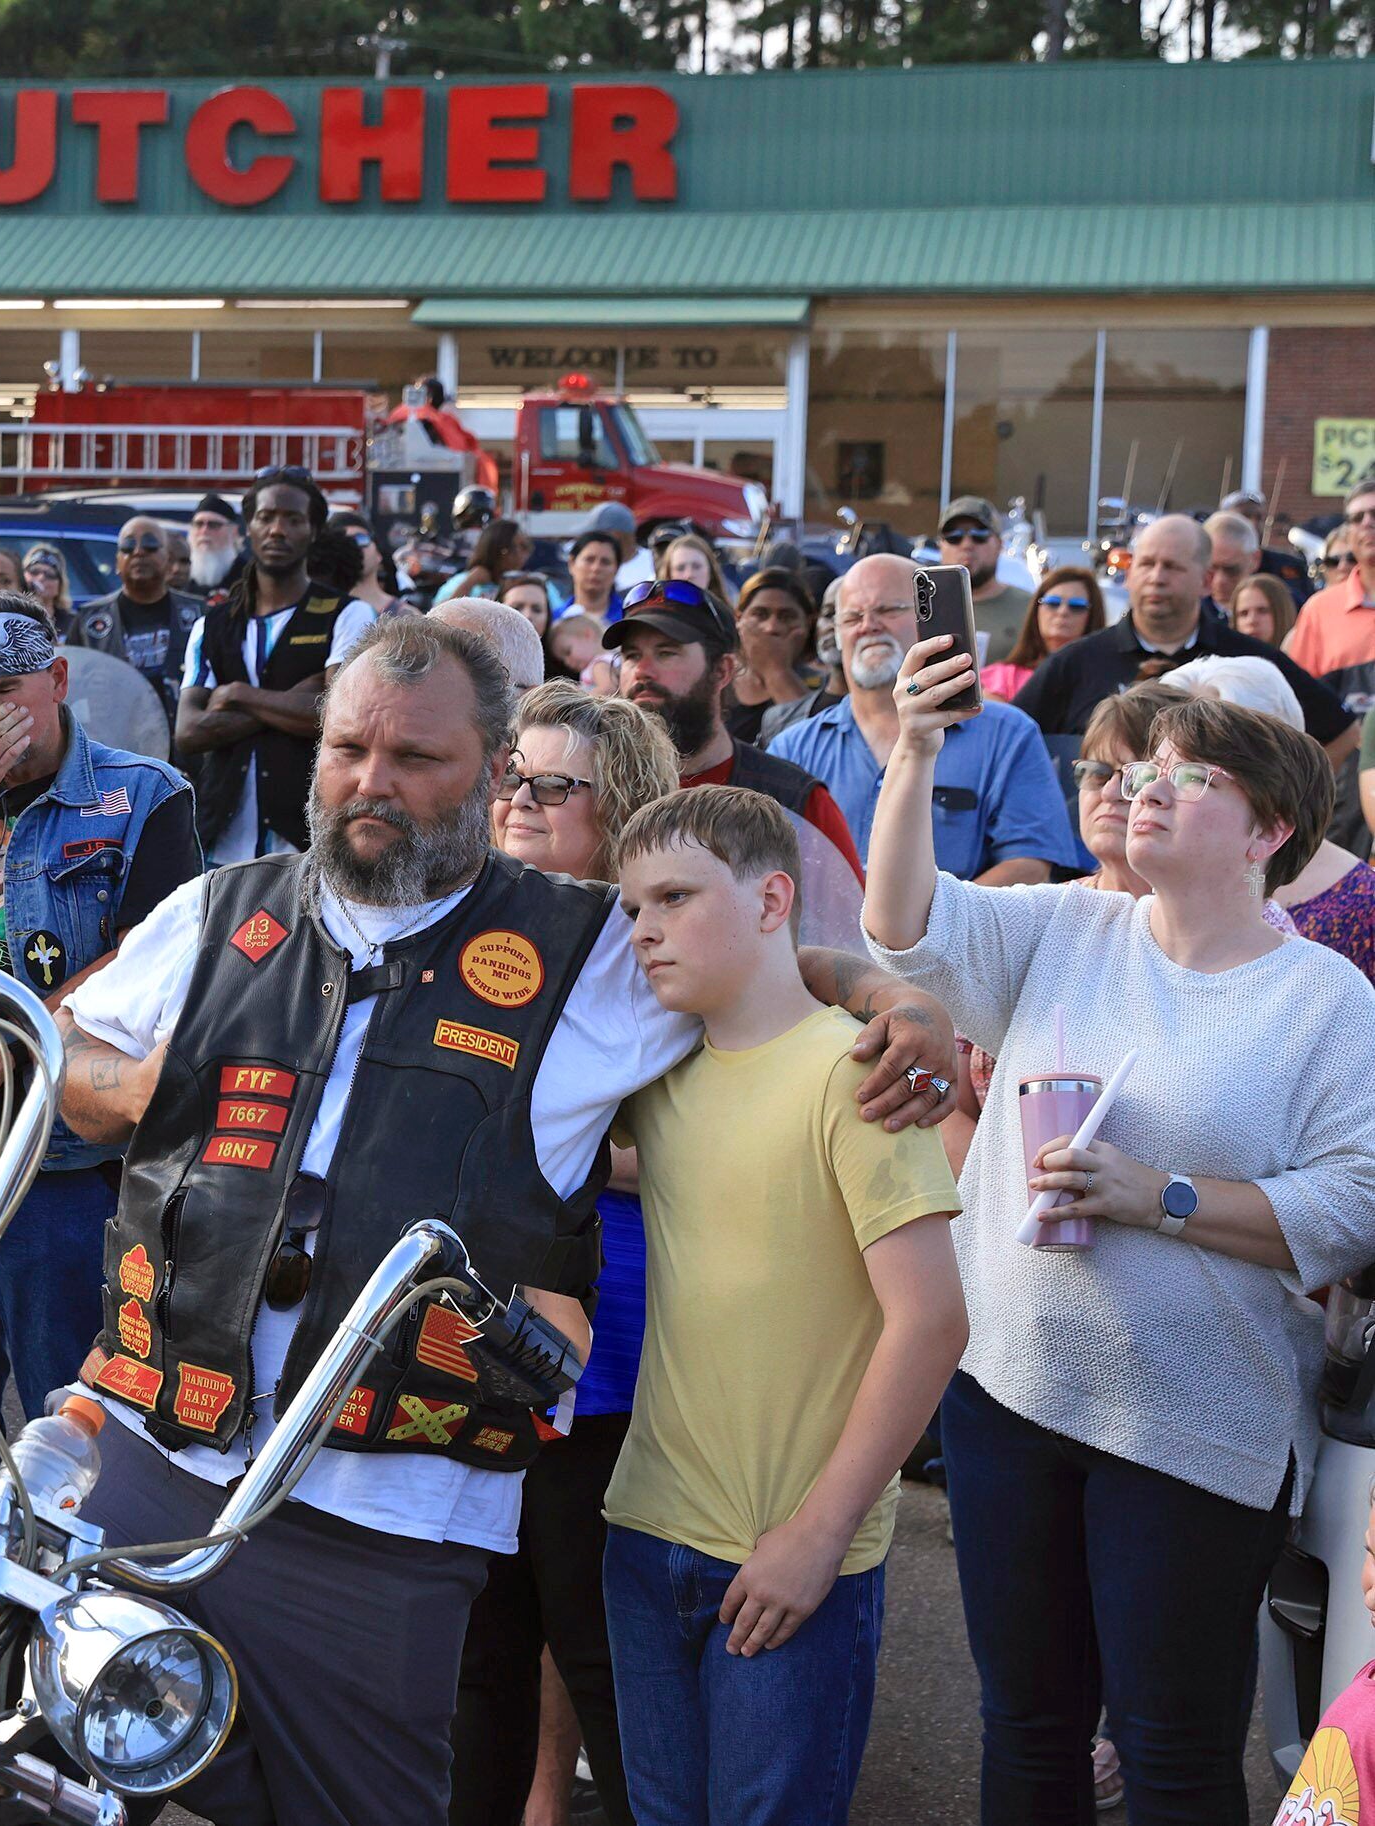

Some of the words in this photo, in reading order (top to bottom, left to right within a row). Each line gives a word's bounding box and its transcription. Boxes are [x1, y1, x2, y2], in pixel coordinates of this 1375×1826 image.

[489, 345, 658, 368] WELCOME
[673, 345, 718, 368] TO
[1324, 427, 1375, 449] PIC
[245, 932, 271, 941] Motor
[247, 918, 271, 935] 13
[244, 940, 269, 949] Cycle
[479, 944, 531, 966] SUPPORT
[471, 956, 532, 981] BANDIDOS
[492, 969, 511, 981] MC
[466, 967, 501, 998] WORLD
[502, 986, 532, 1000] WIDE
[438, 1026, 515, 1061] PRESIDENT
[234, 1069, 277, 1090] FYF
[228, 1105, 269, 1124] 7667
[217, 1141, 258, 1160] 18N7
[184, 1371, 226, 1393] BANDIDO
[184, 1388, 219, 1409] EASY
